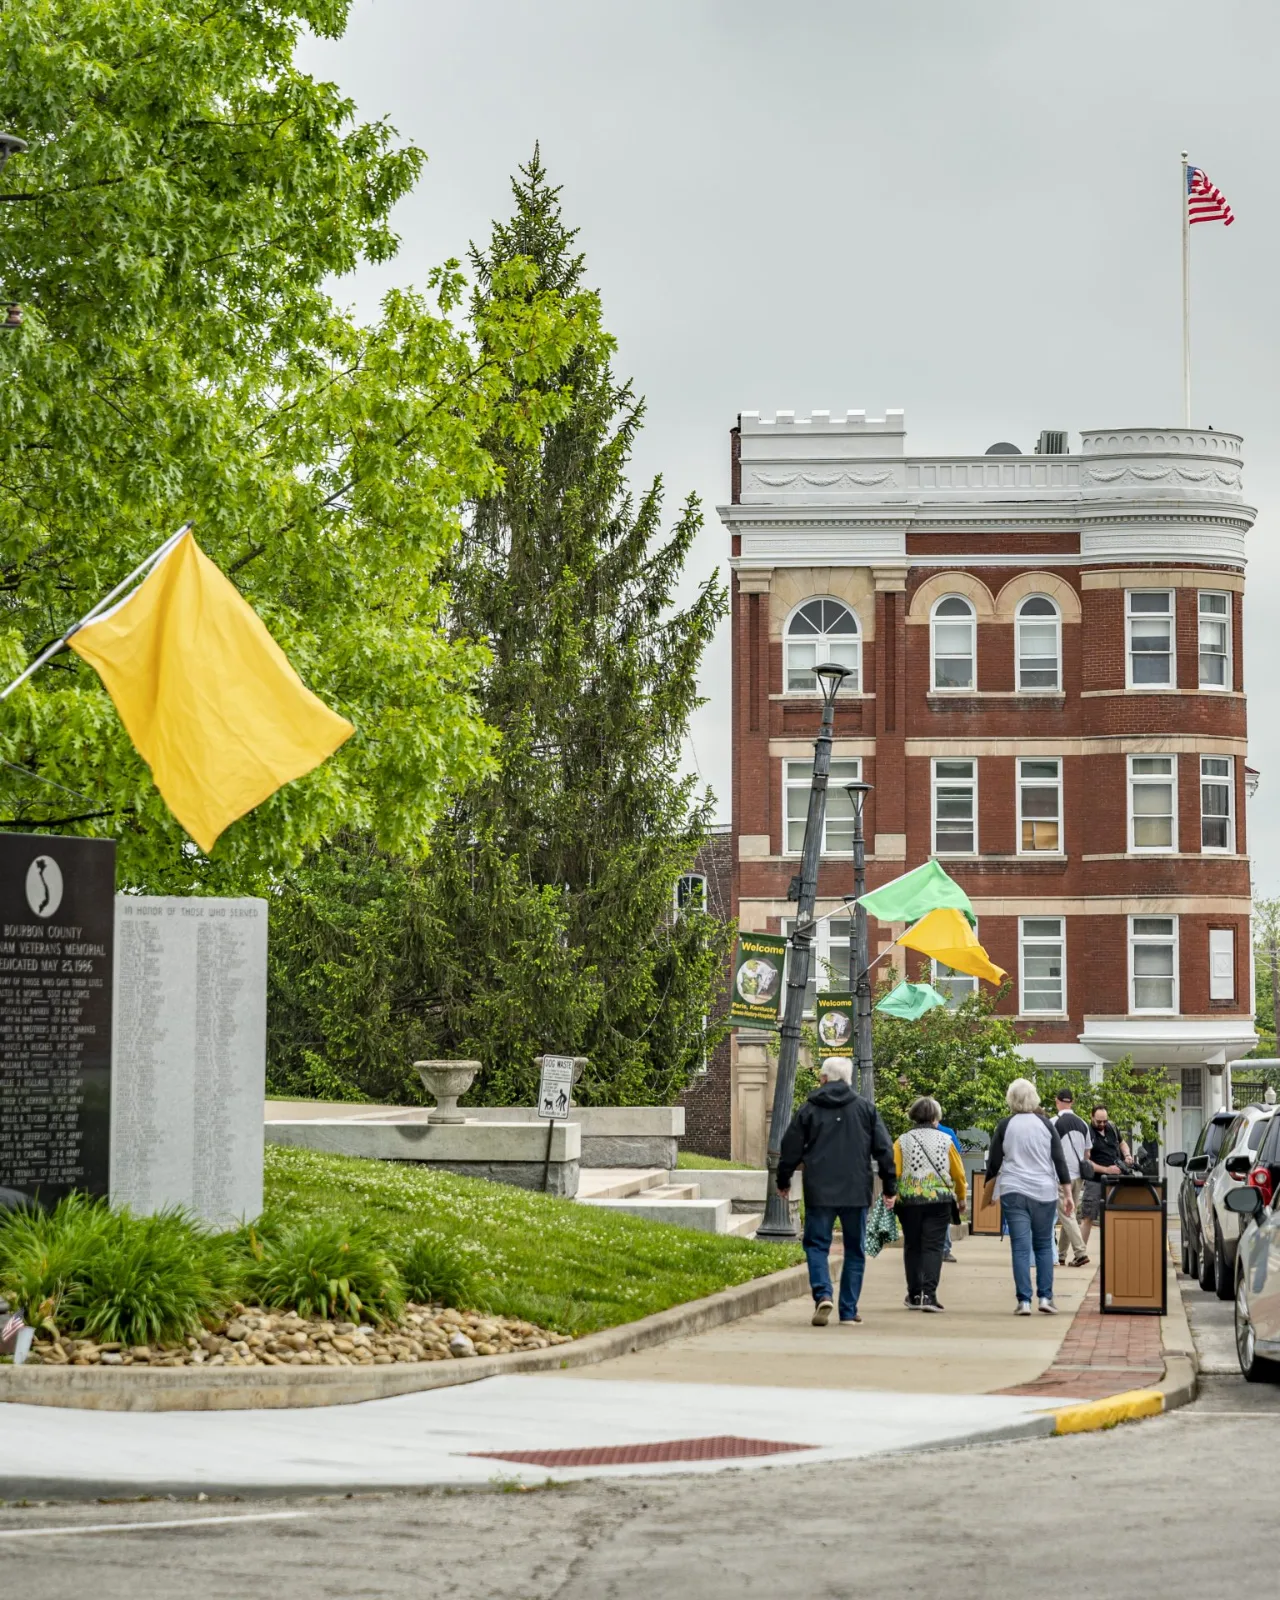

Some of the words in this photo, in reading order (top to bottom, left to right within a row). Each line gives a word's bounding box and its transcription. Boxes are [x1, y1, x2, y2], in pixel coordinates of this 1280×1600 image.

[137, 906, 163, 916] HONOR
[167, 907, 176, 916] OF
[181, 907, 204, 917] THOSE
[208, 908, 226, 917] WHO
[230, 908, 259, 918] SERVED
[4, 924, 44, 937] BOURBON
[48, 926, 83, 939] COUNTY
[0, 942, 16, 954] NAM
[20, 942, 62, 955] VETERANS
[65, 944, 106, 956] MEMORIAL
[742, 942, 784, 955] Welcome
[0, 958, 38, 971] EDICATED
[41, 960, 58, 972] MAY
[732, 1002, 748, 1010] Paris,
[749, 1004, 777, 1014] Kentucky
[545, 1059, 556, 1068] DOG
[557, 1060, 572, 1070] WASTE
